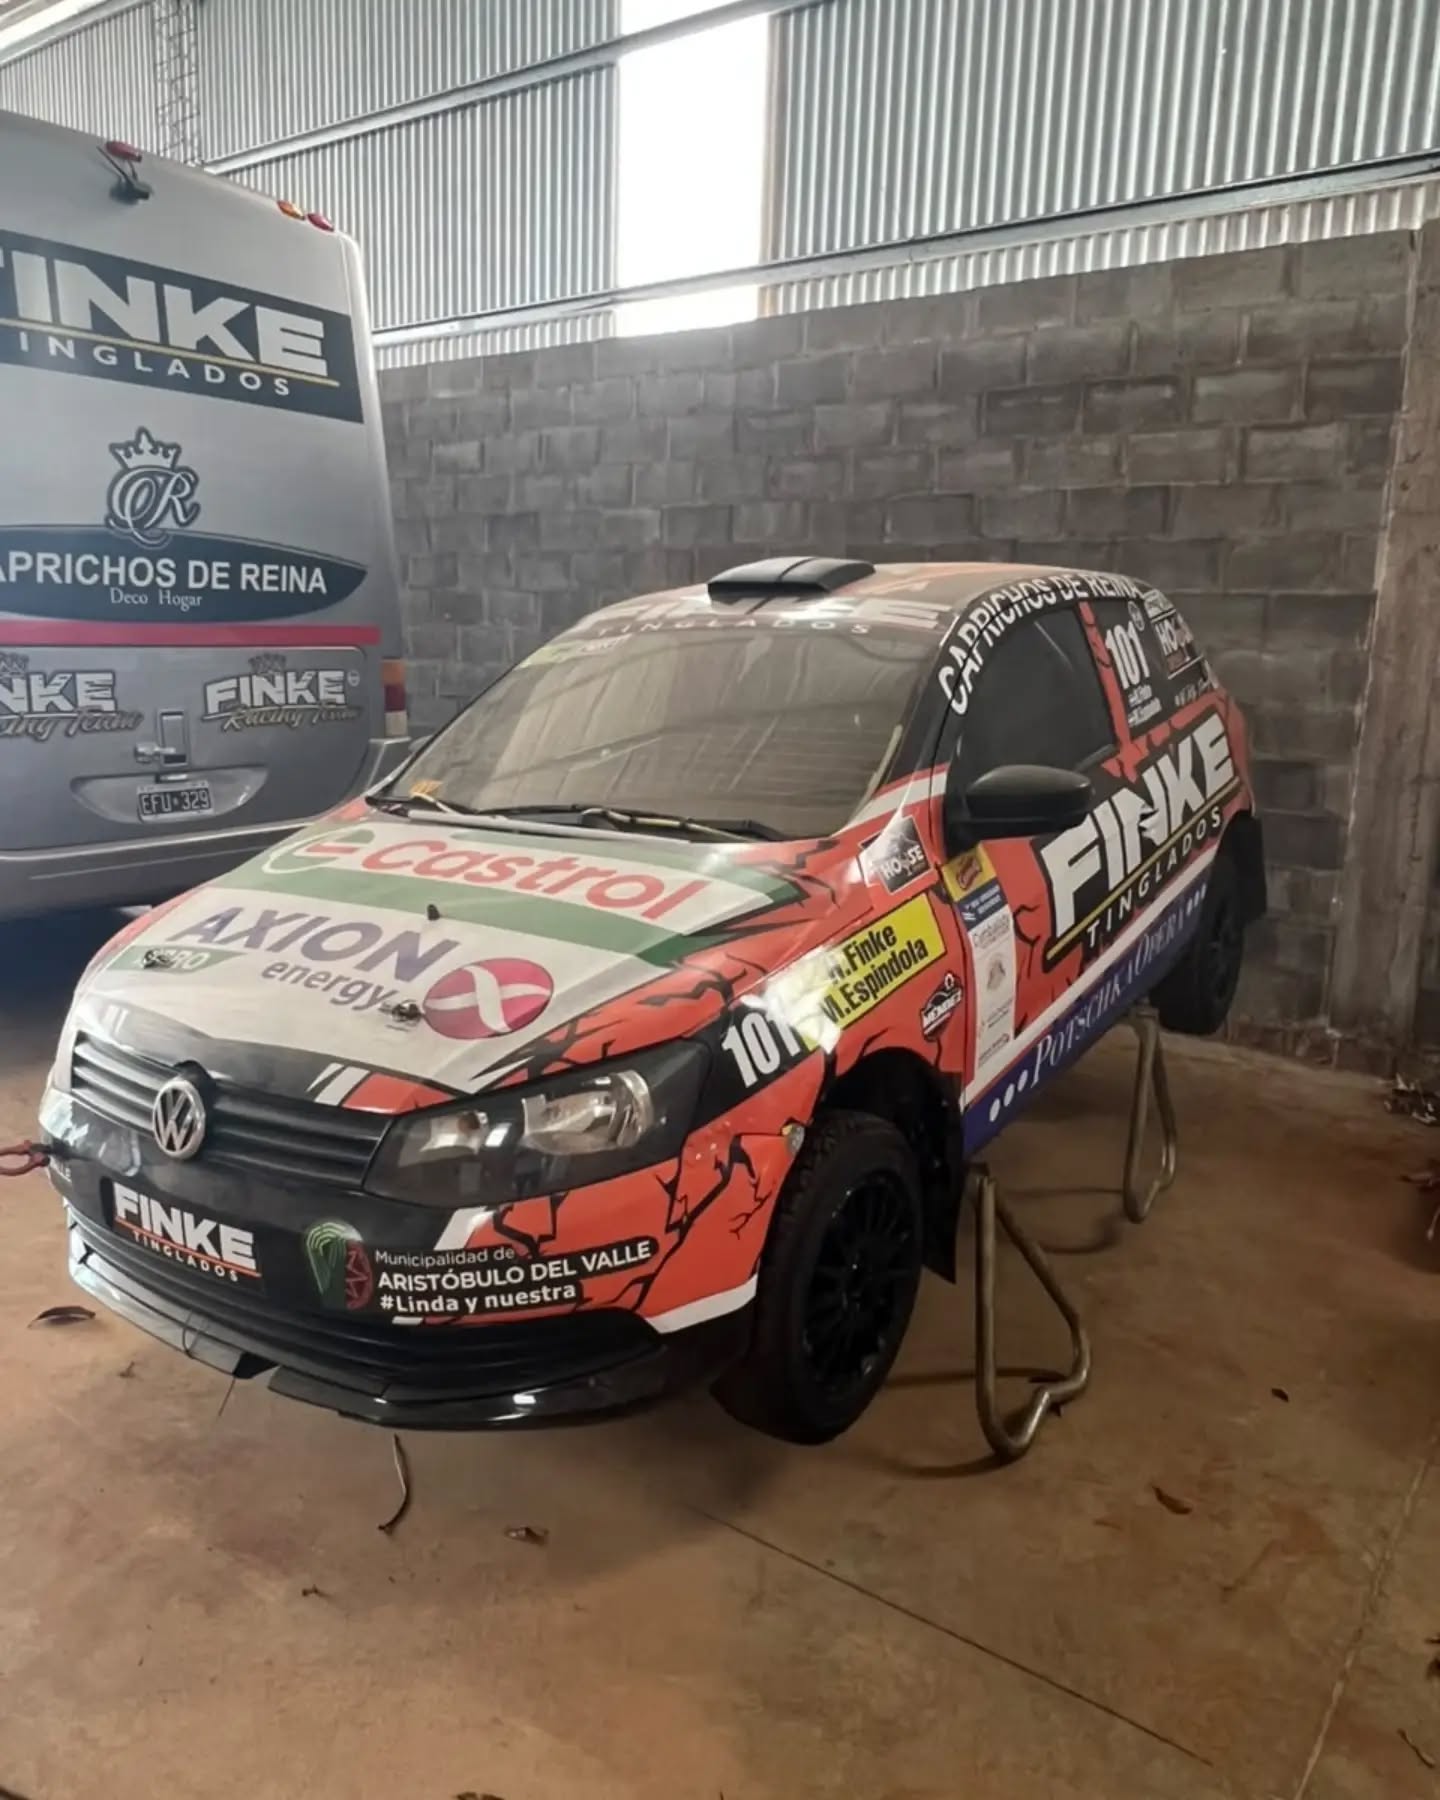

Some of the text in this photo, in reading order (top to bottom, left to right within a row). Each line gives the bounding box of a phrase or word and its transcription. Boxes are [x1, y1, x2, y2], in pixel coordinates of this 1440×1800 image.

[0, 247, 328, 377] INKE
[110, 587, 202, 611] Deco Hogar
[188, 562, 230, 590] DE
[241, 564, 327, 594] REINA
[938, 576, 1057, 714] CAPRICHOS
[1054, 574, 1088, 600] DE
[1078, 574, 1145, 599] REINA
[1105, 621, 1150, 690] 101
[204, 668, 347, 716] FINKE
[181, 790, 210, 811] 329
[1041, 712, 1235, 938] FINKE
[1087, 806, 1223, 948] TINGLADOS
[165, 906, 463, 984] AXION
[262, 960, 391, 1013] energy
[721, 1012, 800, 1089] 101
[114, 1181, 257, 1270] FINKE
[132, 1230, 239, 1282] TINGLADOS
[375, 1247, 515, 1269] Municipalidad de
[378, 1240, 651, 1292] ARISTÓBULO DEL VALLE
[380, 1282, 577, 1314] #Linda y nuestra
